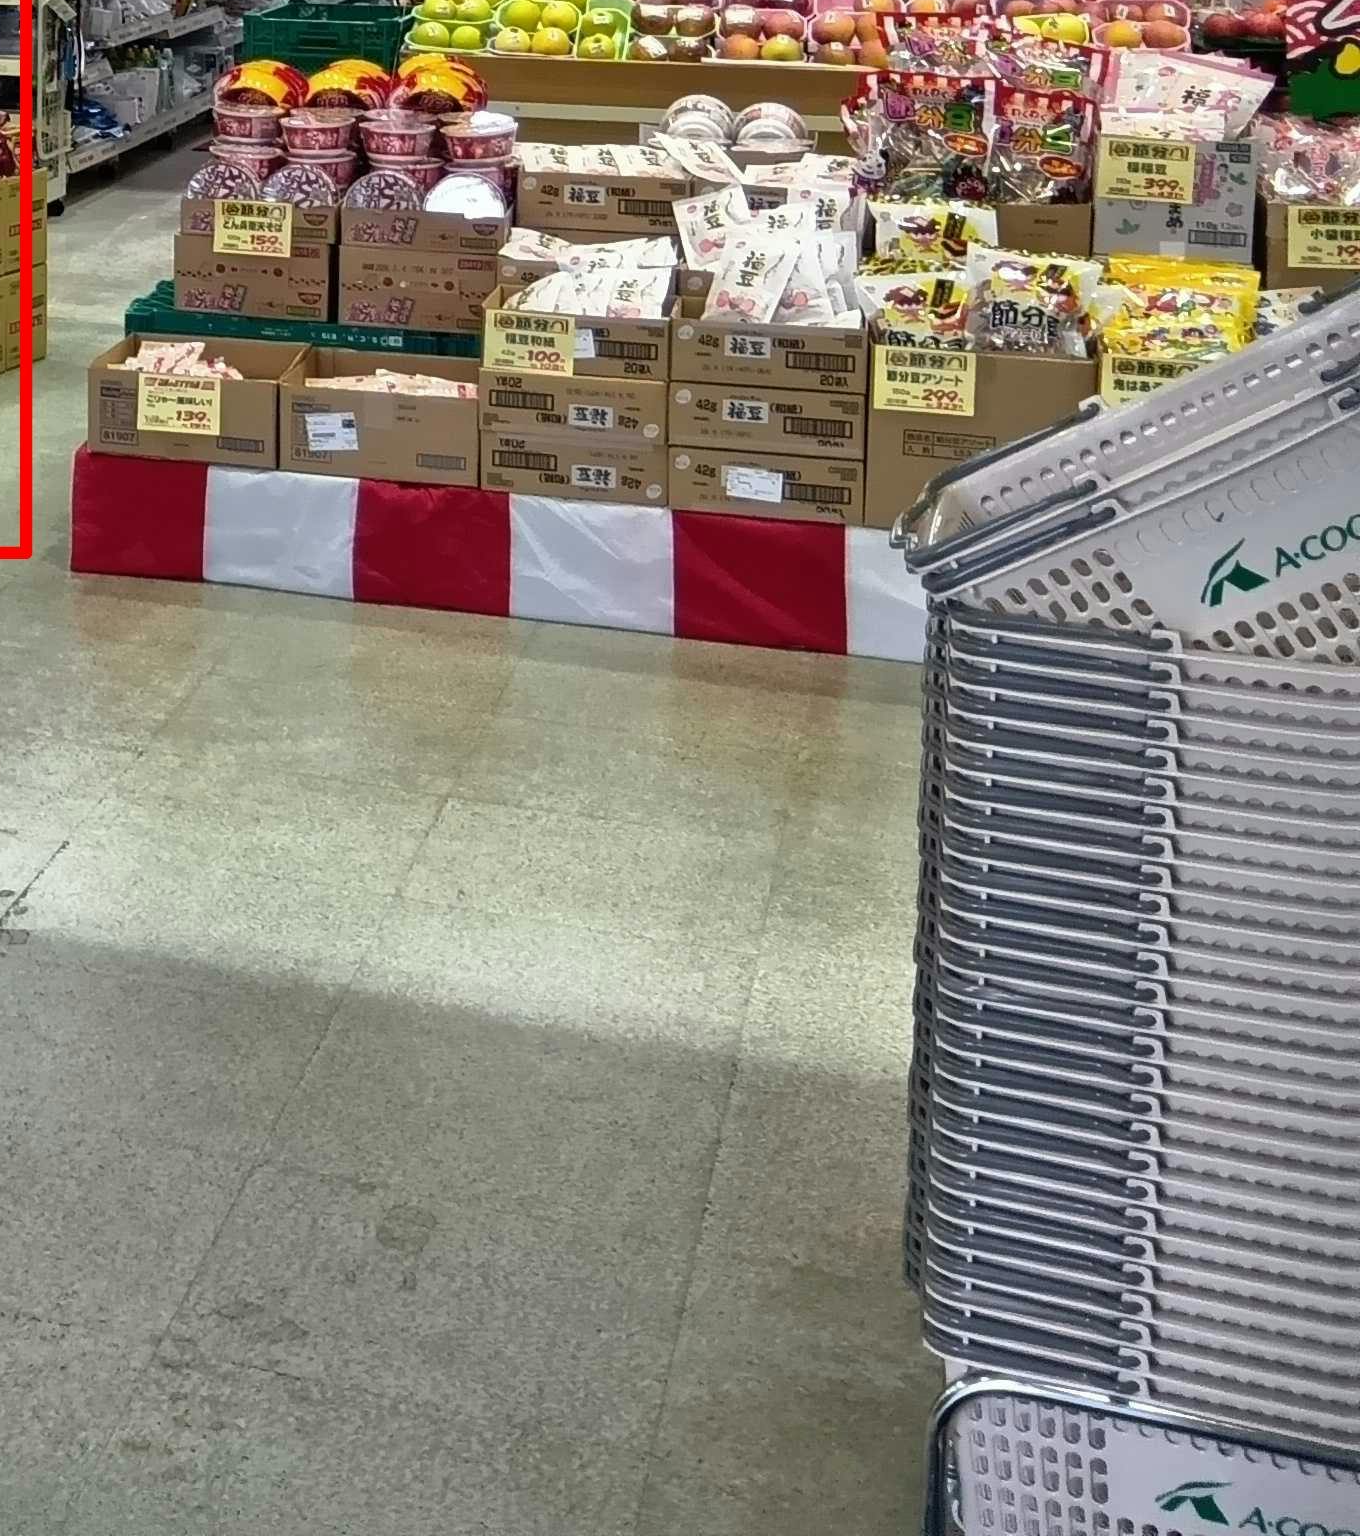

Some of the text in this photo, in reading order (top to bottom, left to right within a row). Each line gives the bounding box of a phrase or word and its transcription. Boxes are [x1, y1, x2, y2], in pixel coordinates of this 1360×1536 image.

[1143, 178, 1179, 191] 399
[541, 186, 560, 197] 42g
[567, 188, 603, 204] 福豆
[249, 234, 278, 246] 159
[698, 336, 720, 348] 42g
[727, 339, 768, 356] 福豆
[527, 350, 561, 363] 100
[922, 388, 958, 402] 299
[175, 411, 207, 422] 139
[695, 400, 718, 412] 42g
[726, 402, 765, 420] 福豆
[694, 465, 716, 477] 42g
